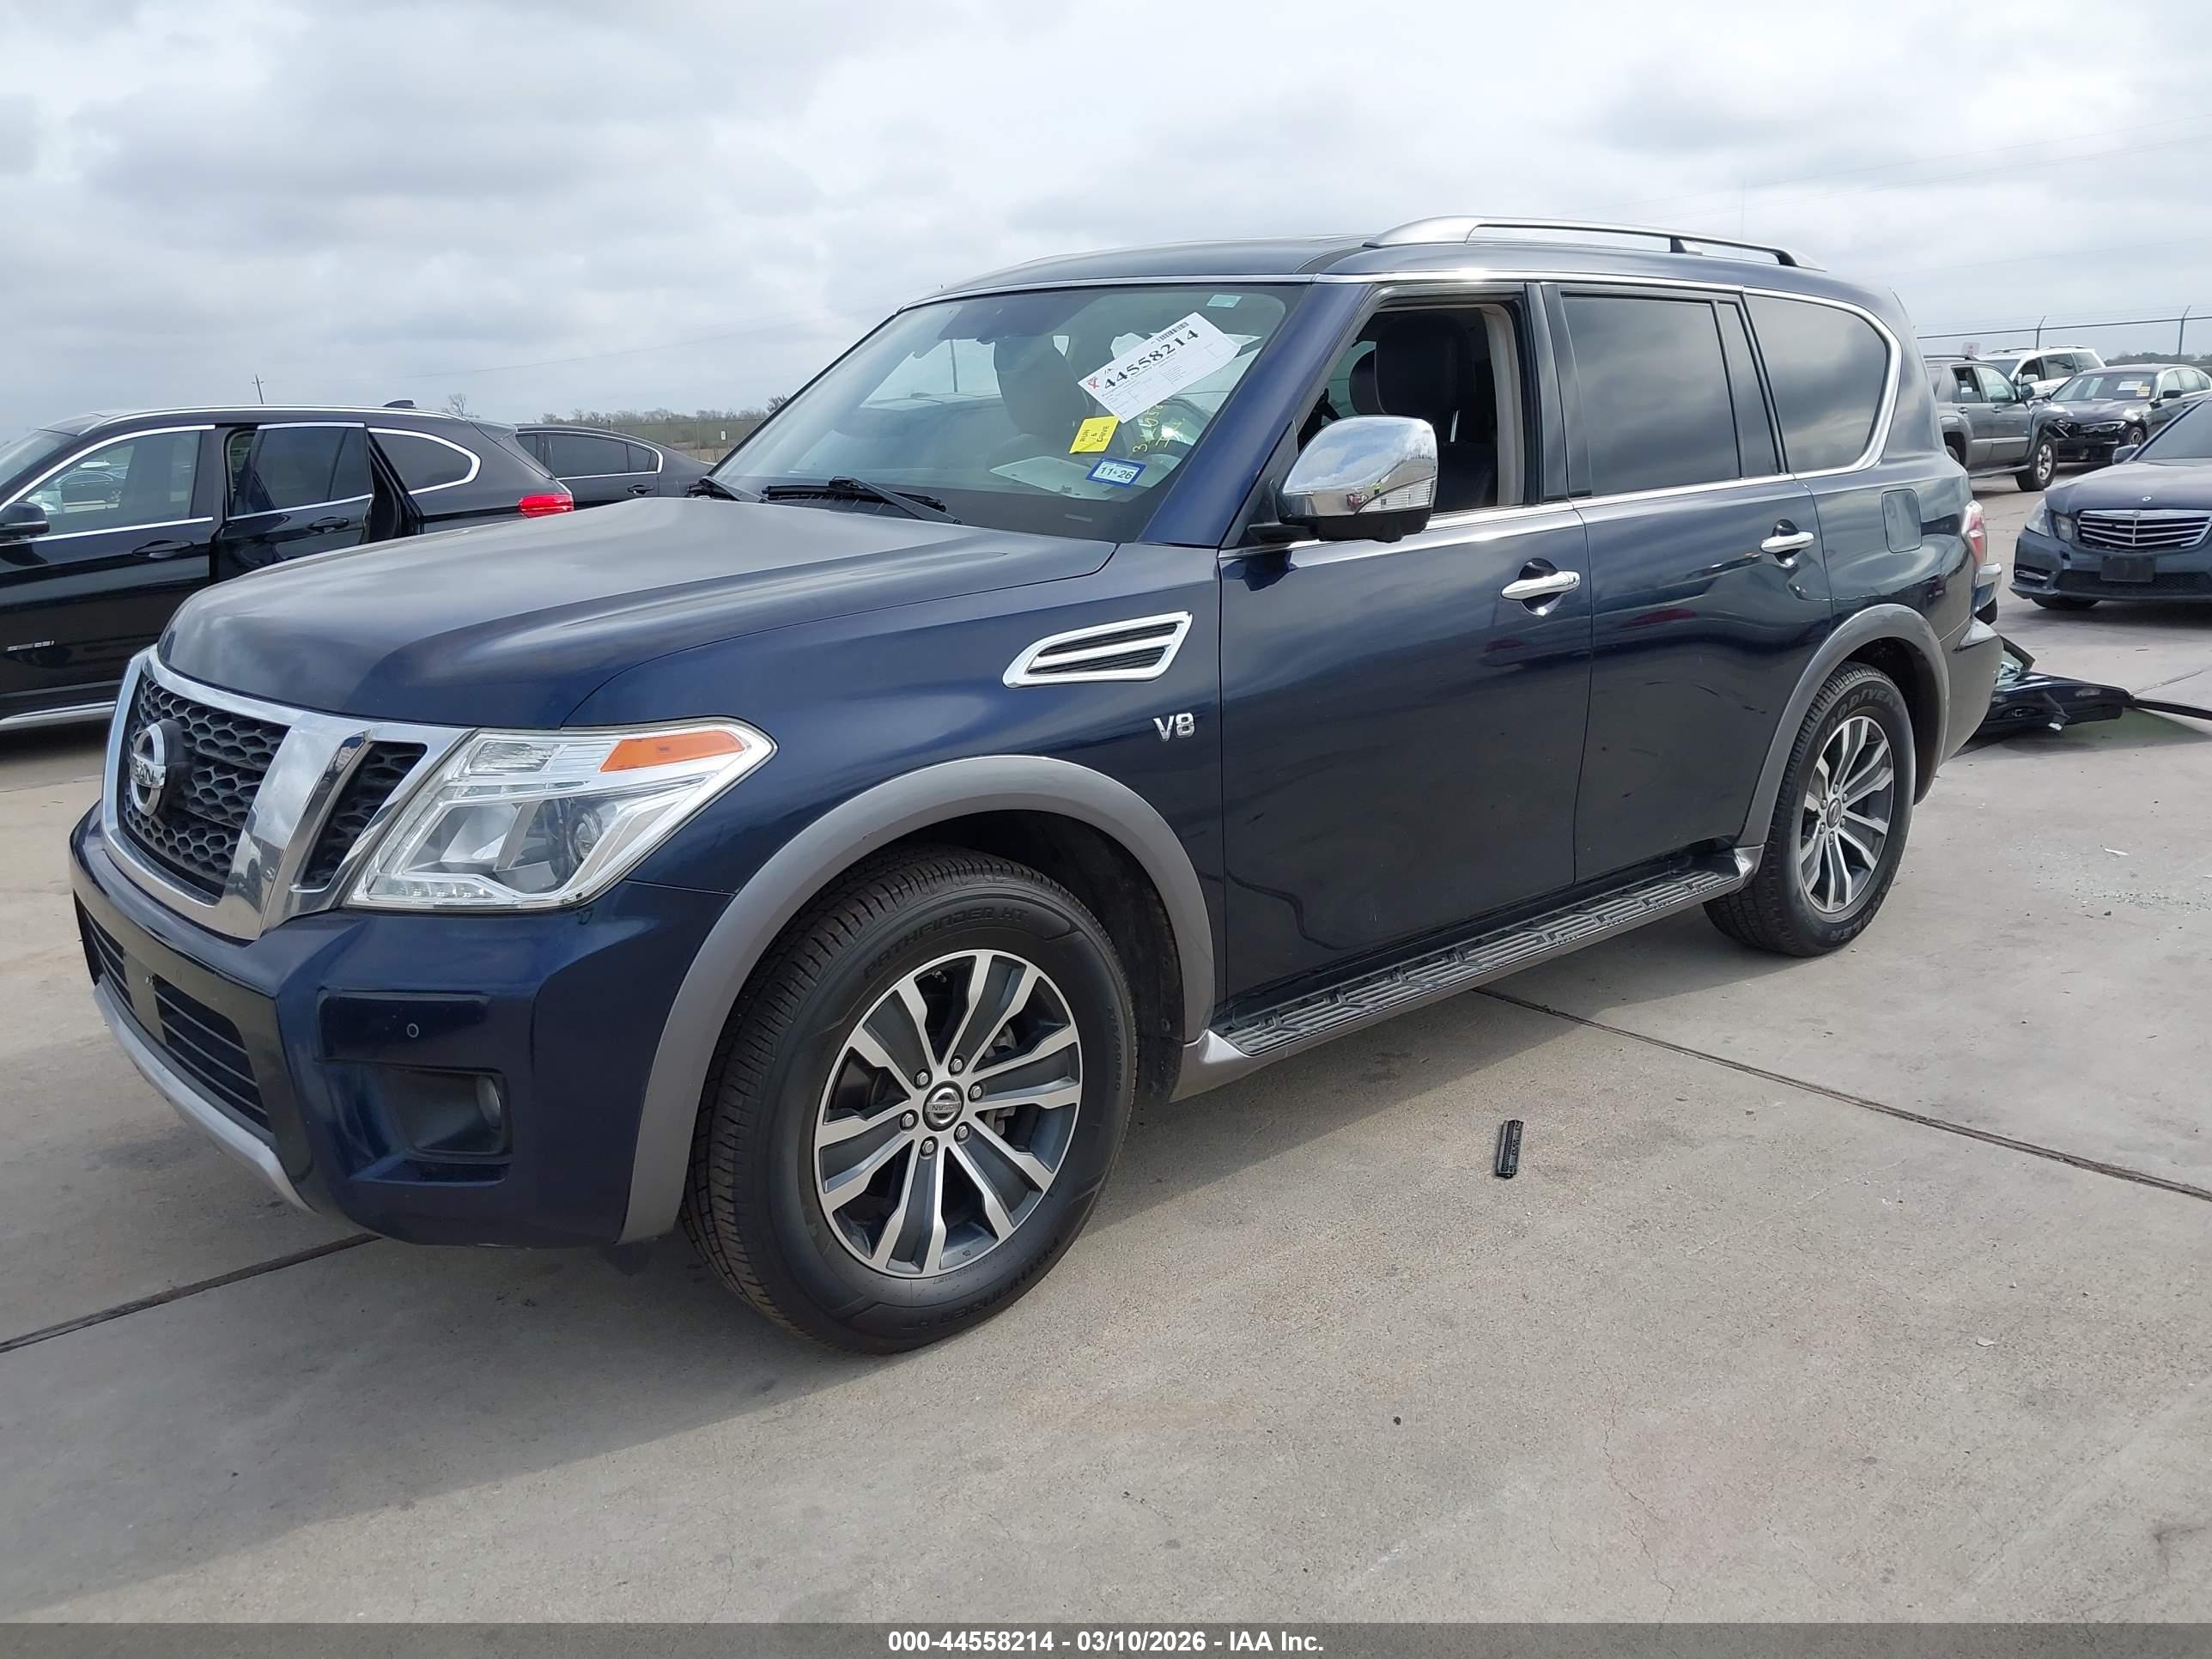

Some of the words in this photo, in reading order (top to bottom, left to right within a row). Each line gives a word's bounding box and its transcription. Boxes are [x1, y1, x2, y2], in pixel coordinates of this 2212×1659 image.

[1104, 330, 1199, 389] 44558214
[1152, 712, 1194, 741] V8
[864, 907, 995, 980] PATHFINDER
